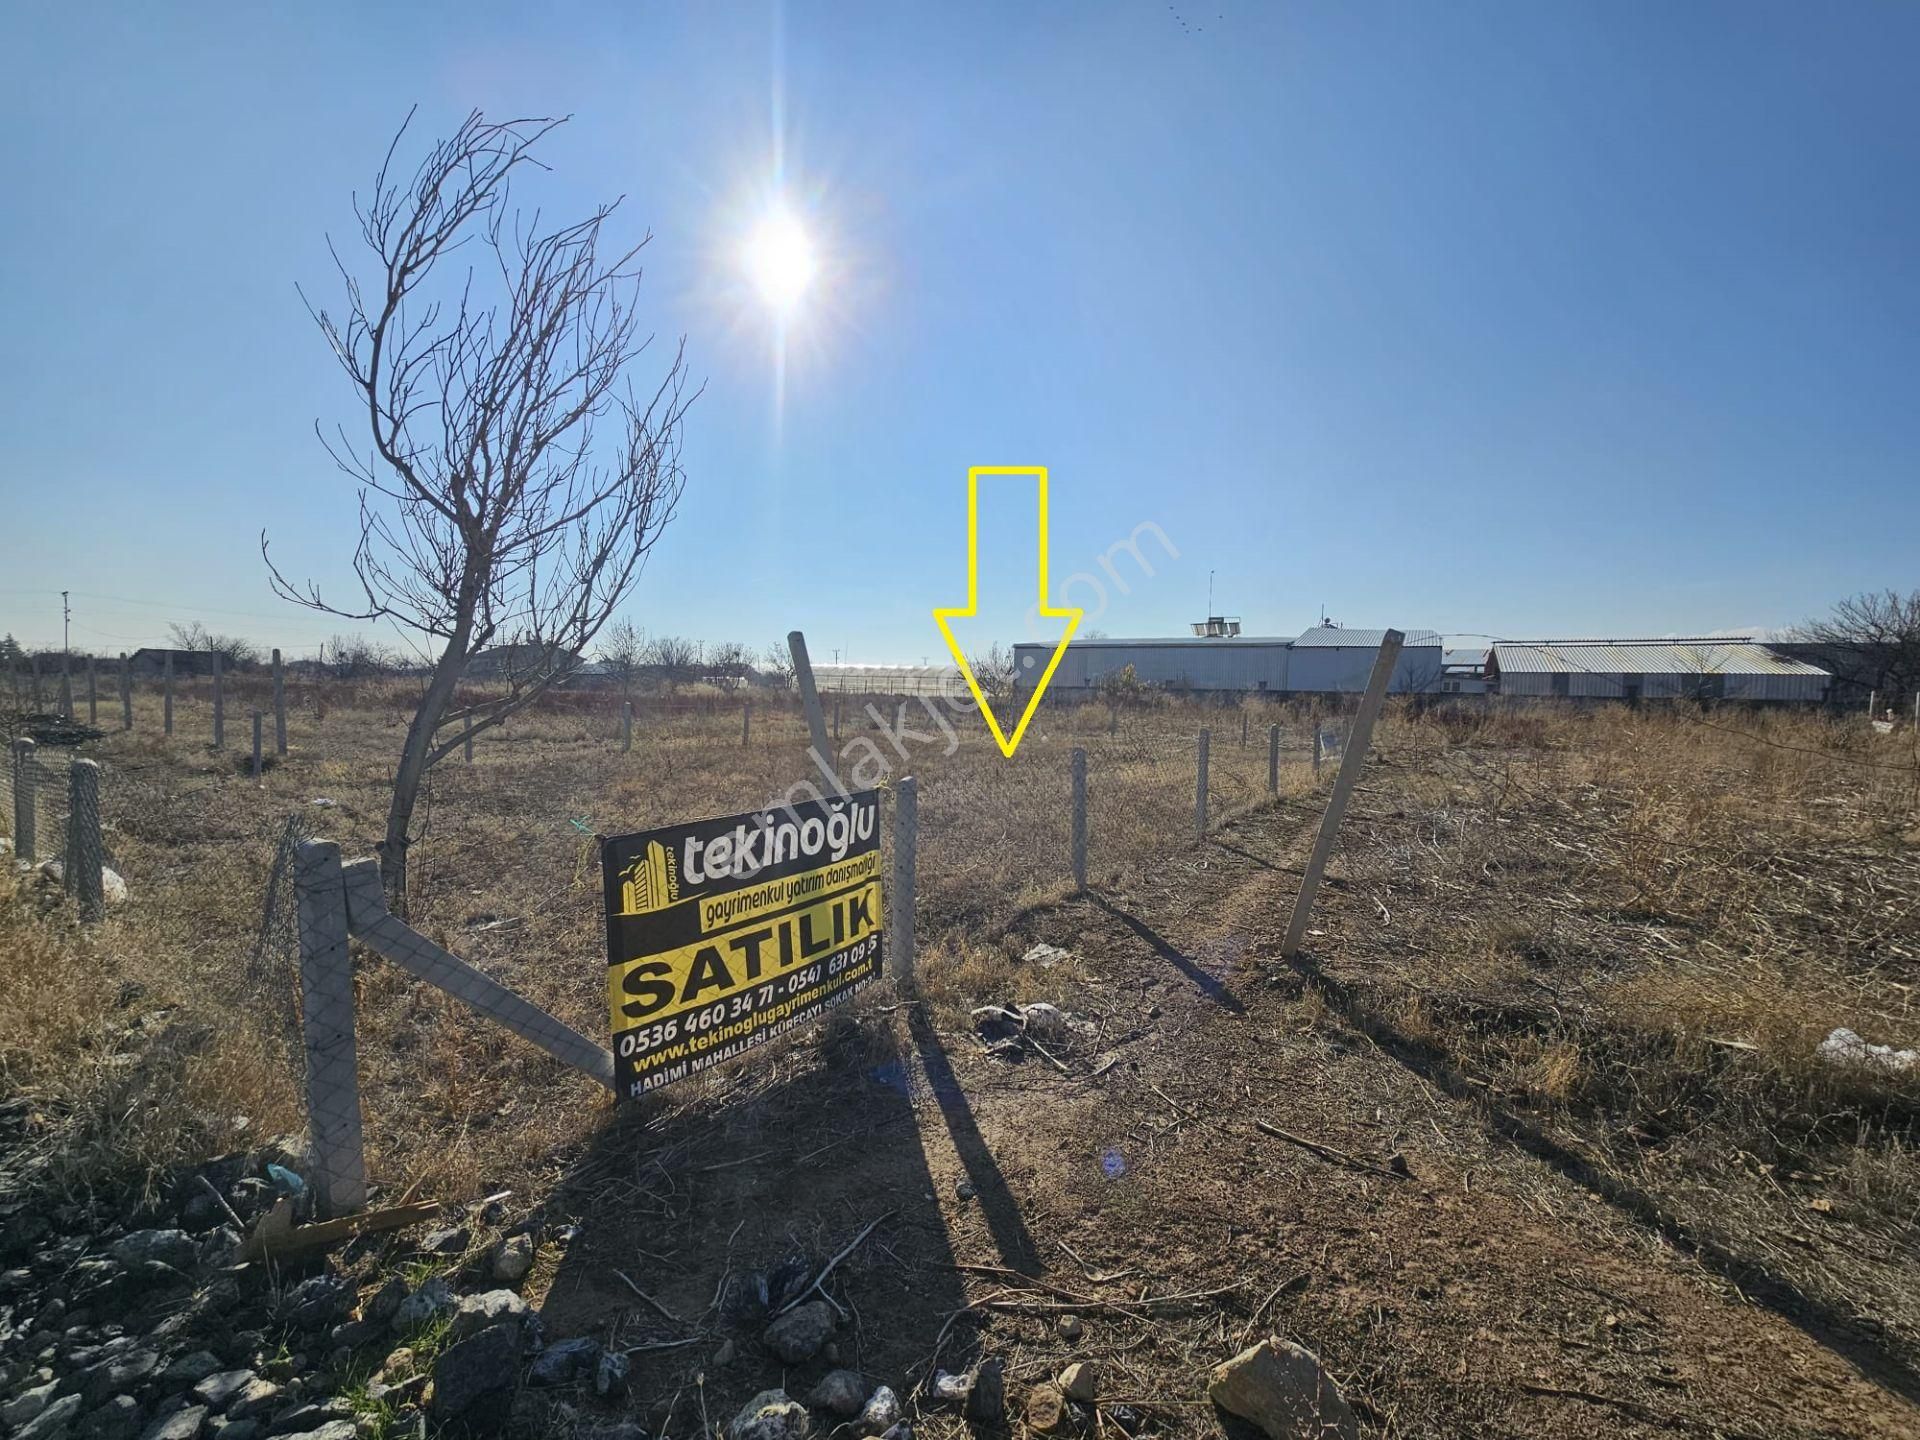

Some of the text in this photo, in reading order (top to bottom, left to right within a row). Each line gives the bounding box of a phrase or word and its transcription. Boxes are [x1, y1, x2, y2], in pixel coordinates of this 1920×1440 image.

[683, 802, 875, 885] tekinoğlu
[706, 883, 784, 928] gayrimenkul
[786, 874, 824, 903] yatırım
[620, 888, 875, 1019] SATILIK
[620, 1019, 678, 1057] 0536
[684, 1003, 725, 1033] 460
[730, 996, 753, 1018] 34
[758, 985, 774, 1007] 71
[788, 964, 821, 993] 0541
[850, 943, 865, 964] 09
[630, 1060, 687, 1097] HADİMİ
